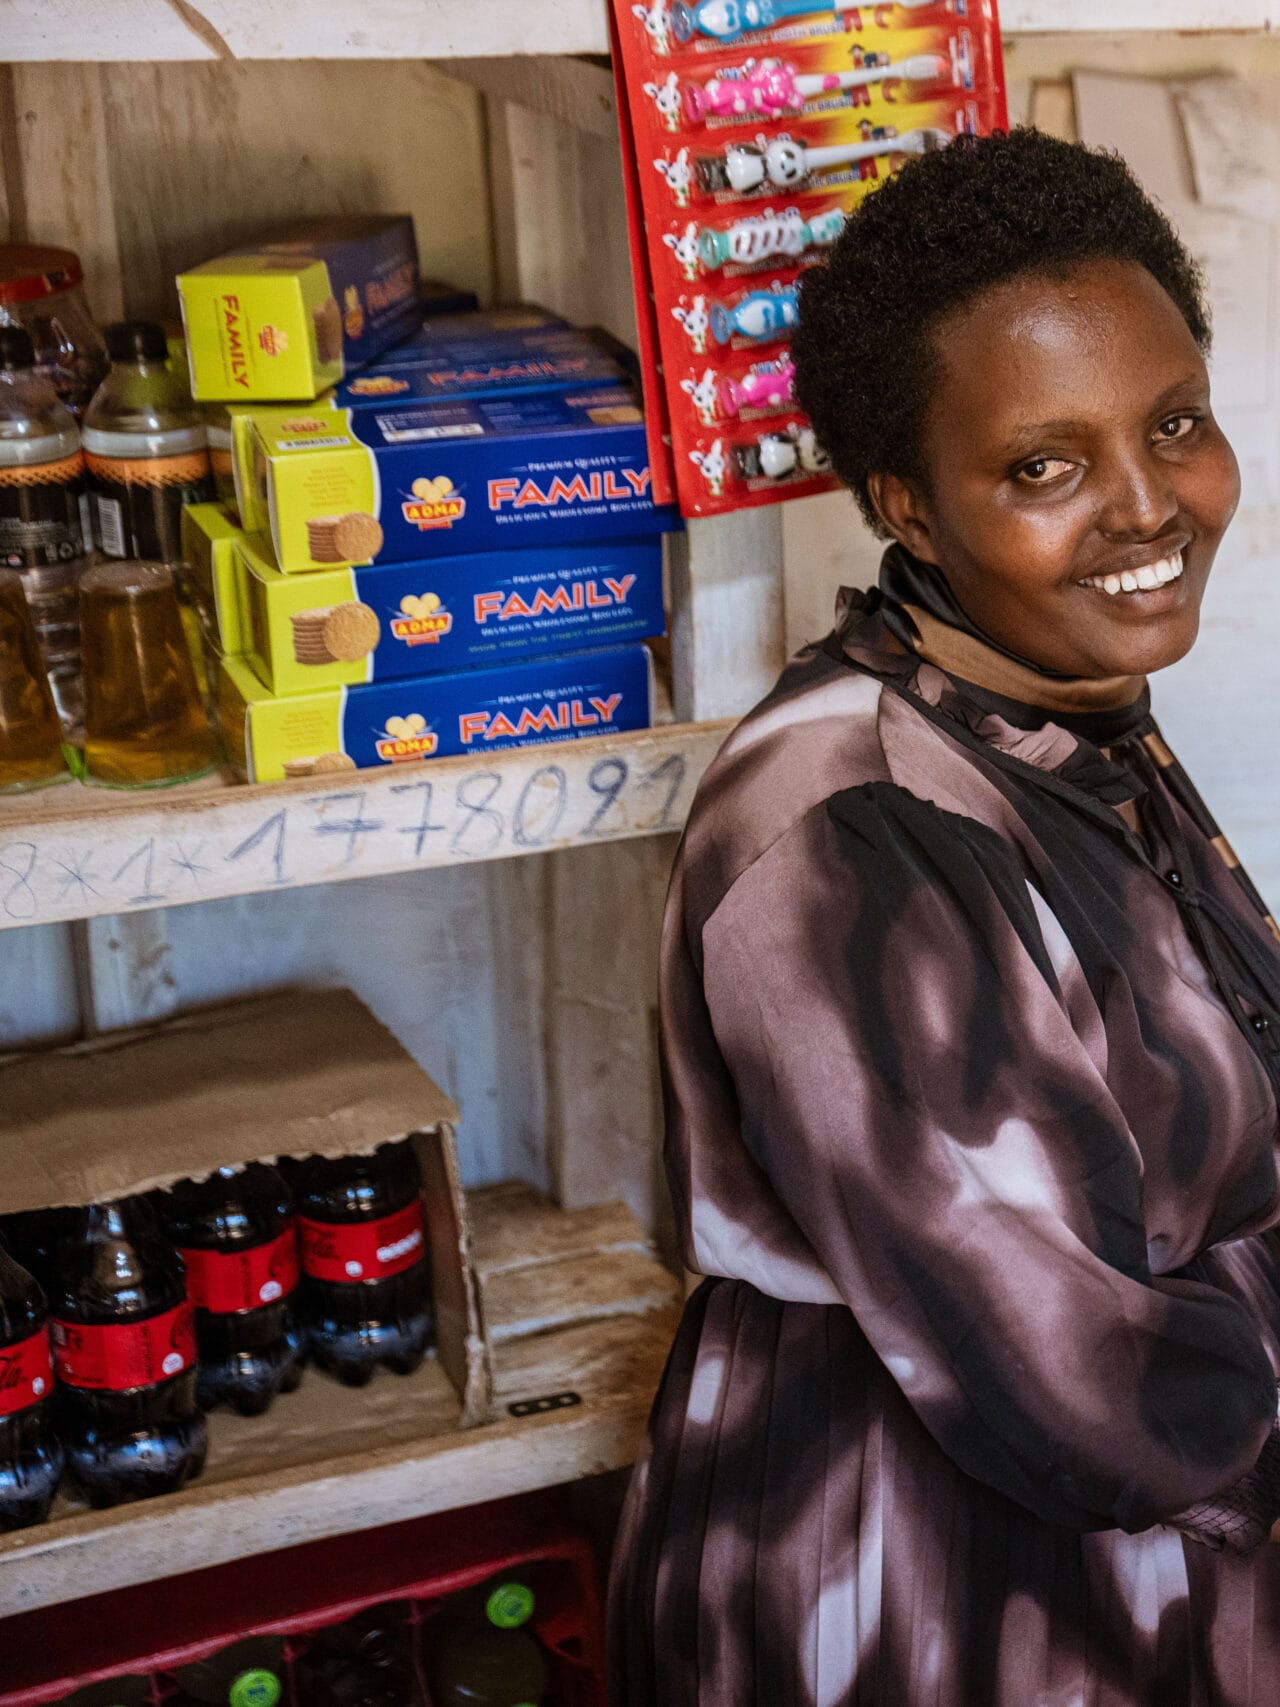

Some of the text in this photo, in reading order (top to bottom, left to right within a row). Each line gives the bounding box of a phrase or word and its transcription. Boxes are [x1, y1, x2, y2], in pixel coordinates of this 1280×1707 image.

[221, 293, 250, 389] FAMILY
[487, 466, 651, 510] FAMILY
[408, 502, 460, 520] ADMA
[473, 573, 637, 624] FAMILY
[397, 617, 447, 636] ADMA
[459, 692, 623, 744] FAMILY
[383, 737, 432, 758] ADMA
